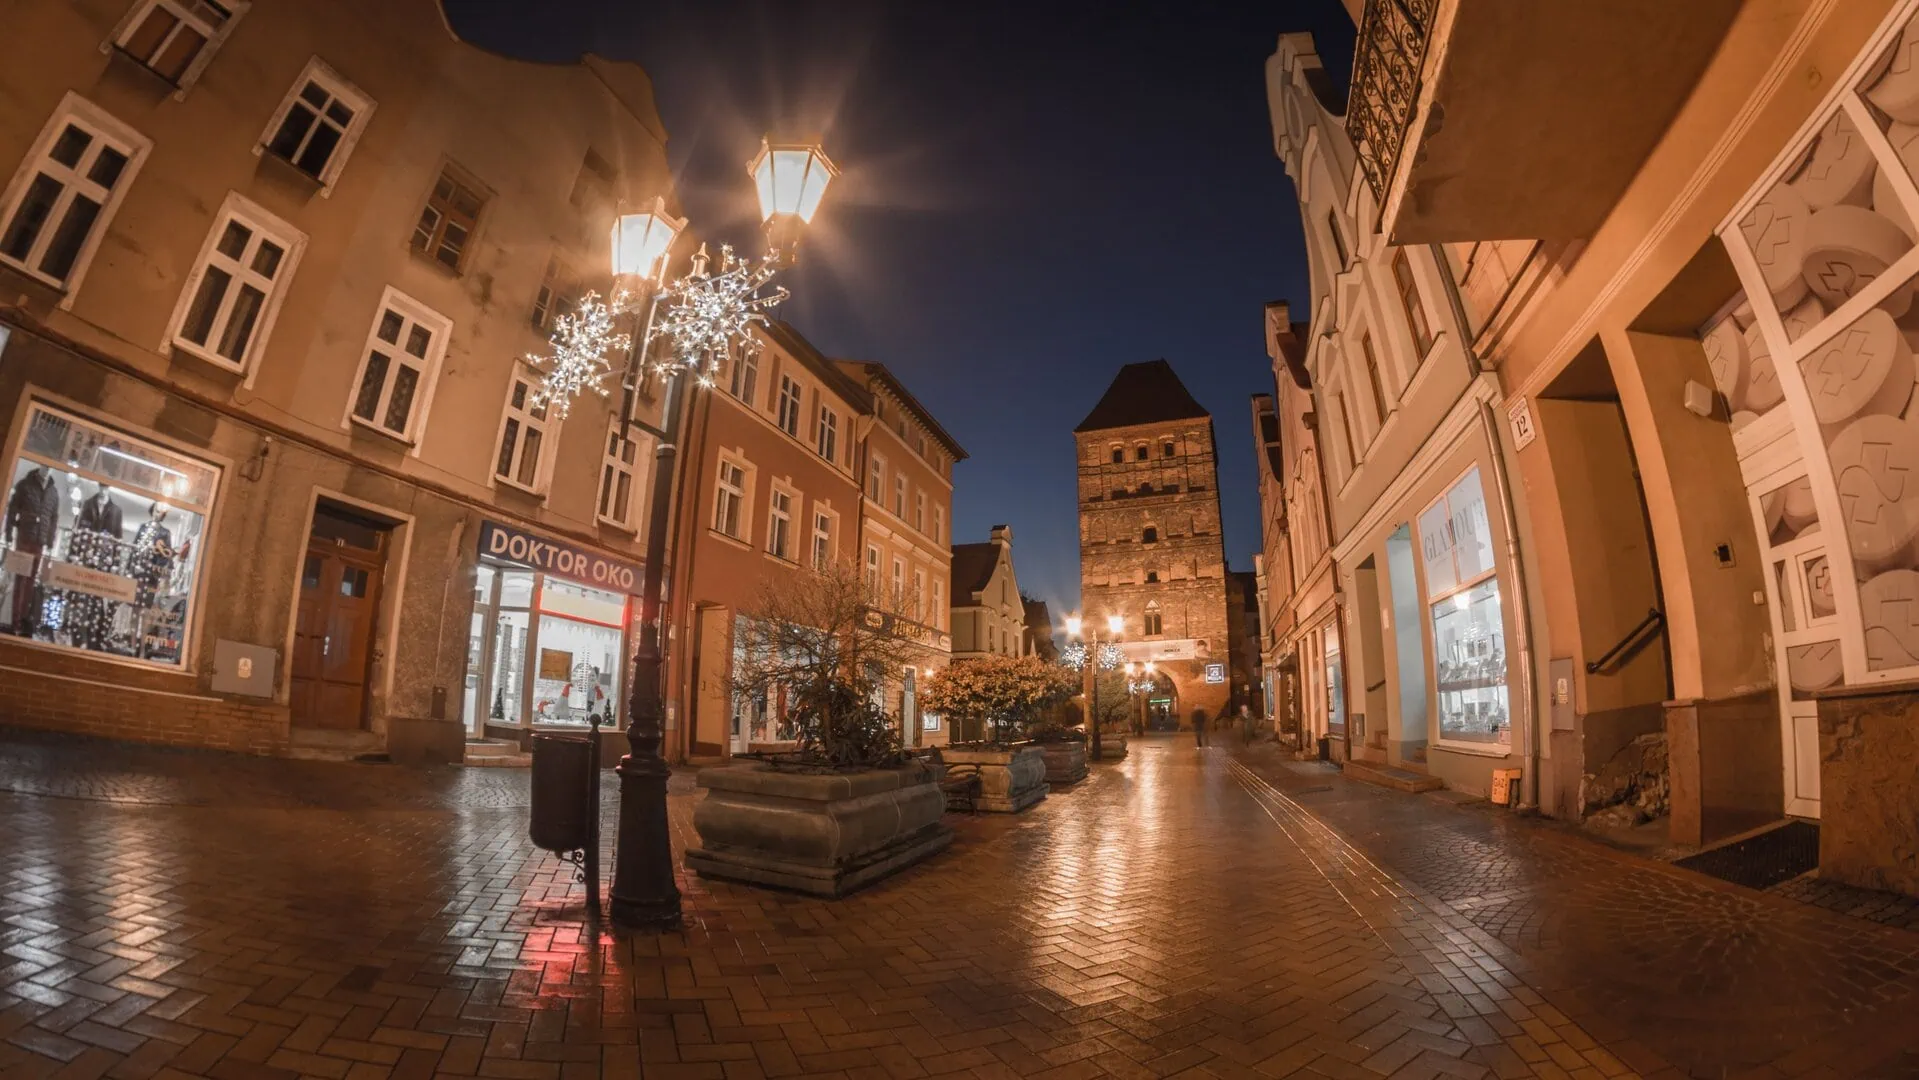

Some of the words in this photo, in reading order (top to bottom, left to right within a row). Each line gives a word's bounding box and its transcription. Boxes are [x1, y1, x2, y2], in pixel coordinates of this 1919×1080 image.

[1516, 415, 1528, 437] 12
[490, 528, 588, 578] DOKTOR
[592, 560, 634, 589] OKO
